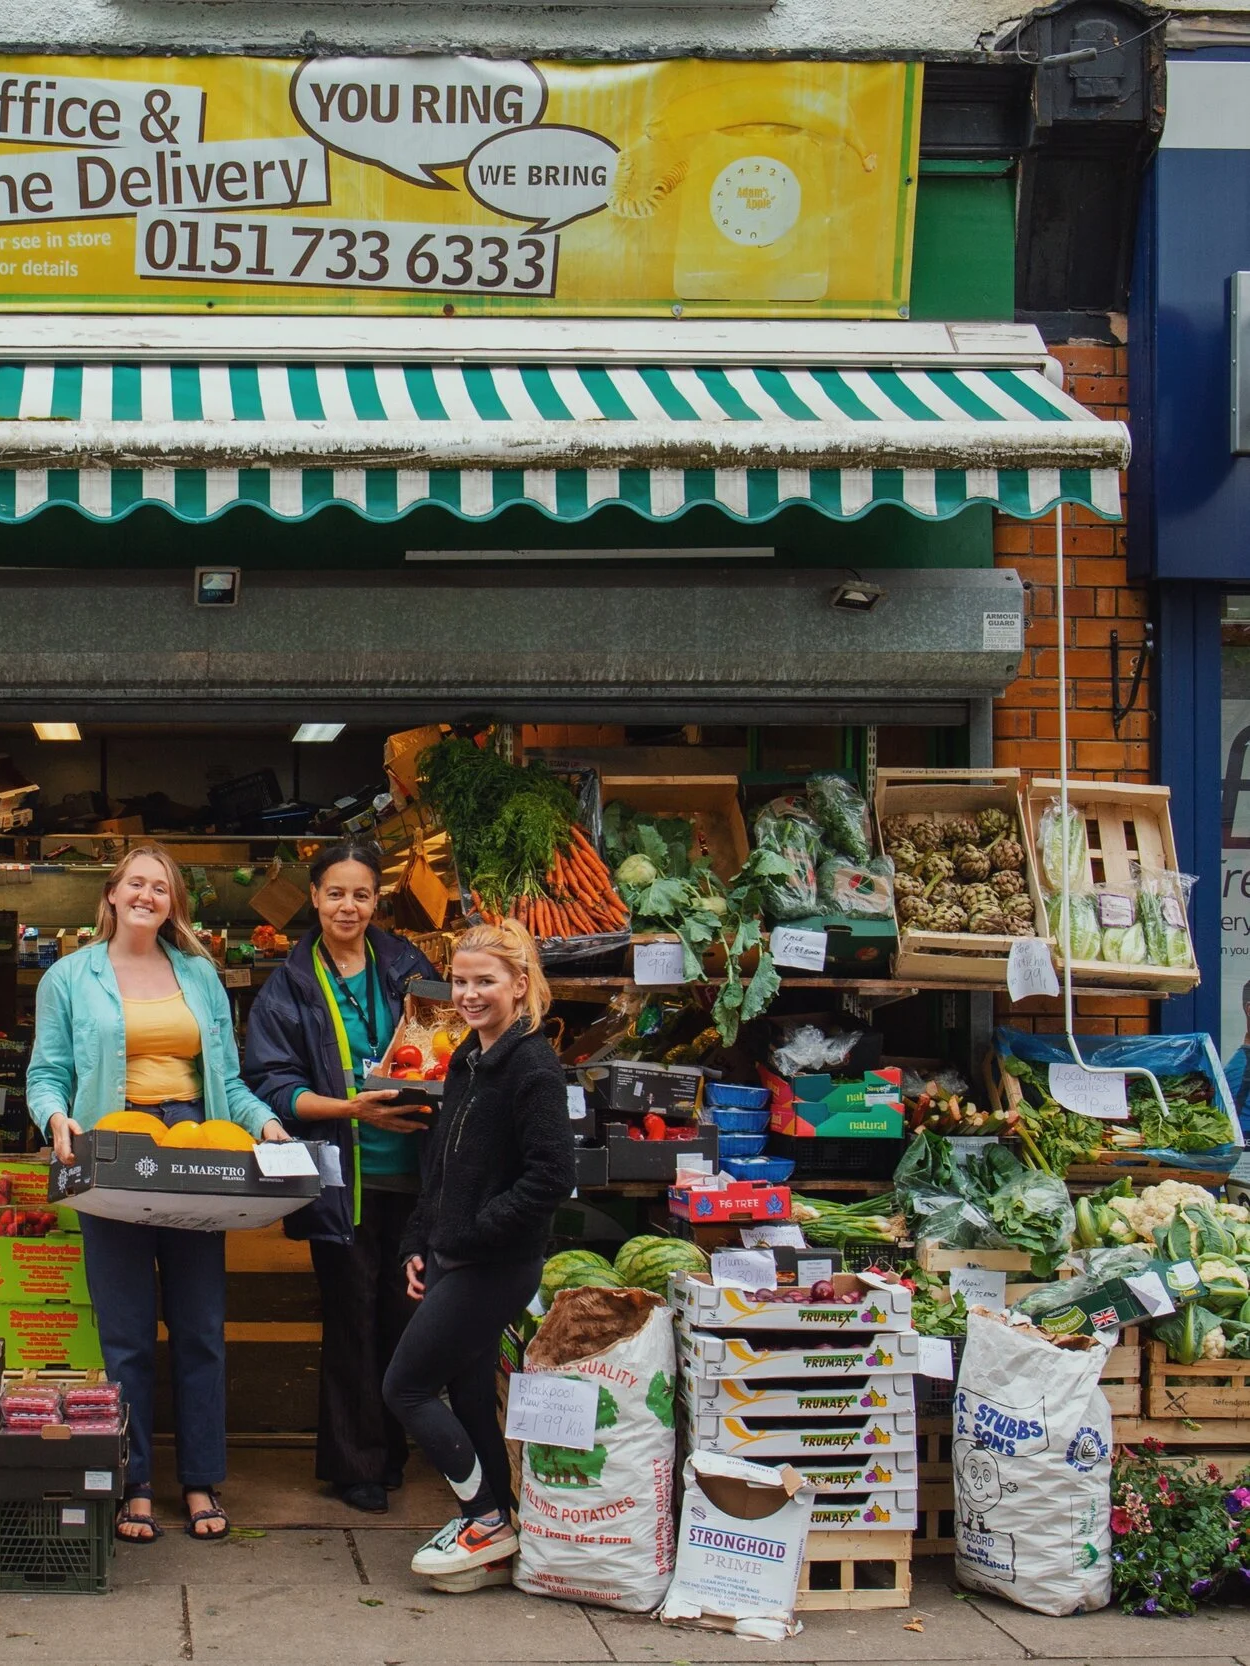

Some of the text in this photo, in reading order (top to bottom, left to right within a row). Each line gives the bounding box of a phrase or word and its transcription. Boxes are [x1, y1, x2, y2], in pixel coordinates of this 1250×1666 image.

[310, 84, 523, 125] YOU RING
[140, 89, 180, 145] &
[77, 150, 308, 210] Delivery
[478, 164, 607, 187] WE BRING
[12, 236, 41, 250] see
[47, 232, 62, 248] in
[67, 230, 111, 248] store
[145, 219, 545, 290] 0151 733 6333
[22, 260, 78, 278] details
[849, 1121, 887, 1131] natural
[170, 1163, 246, 1178] EL MAESTRO
[718, 1198, 760, 1208] FIG TREE
[800, 1309, 855, 1328] FRUMAEX
[805, 1354, 861, 1373] FRUMAEX
[518, 1379, 575, 1399] Blackpool
[799, 1395, 856, 1414] FRUMAEX
[565, 1418, 586, 1437] Kilo
[974, 1402, 1044, 1441] STUBBS
[802, 1432, 858, 1451] FRUMAEX
[957, 1415, 1017, 1457] & SONS
[653, 1457, 665, 1513] QUALITY
[561, 1496, 636, 1524] POTATOES
[545, 1527, 572, 1543] from
[574, 1533, 596, 1544] the
[599, 1534, 632, 1546] farm
[655, 1517, 666, 1576] ORCHARD
[688, 1528, 787, 1560] STRONGHOLD
[961, 1530, 996, 1548] ACCORD
[703, 1552, 763, 1577] PRIME
[727, 1576, 748, 1585] QUALITY
[547, 1585, 582, 1597] ASSURED
[583, 1590, 622, 1601] PRODUCE
